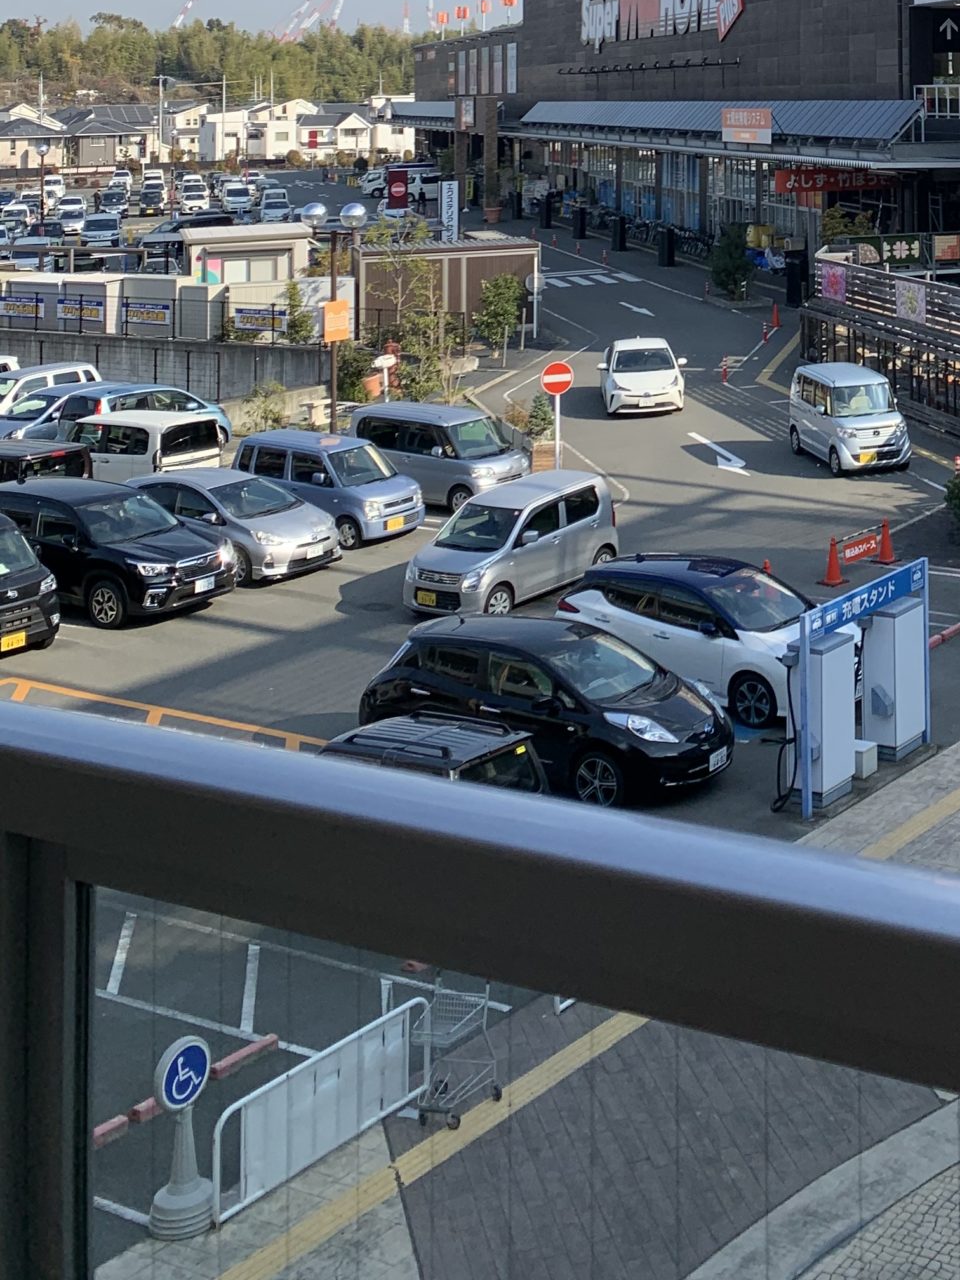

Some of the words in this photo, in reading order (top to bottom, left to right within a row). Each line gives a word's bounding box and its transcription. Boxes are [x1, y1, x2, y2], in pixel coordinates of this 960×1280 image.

[842, 580, 895, 621] 充電スタンド
